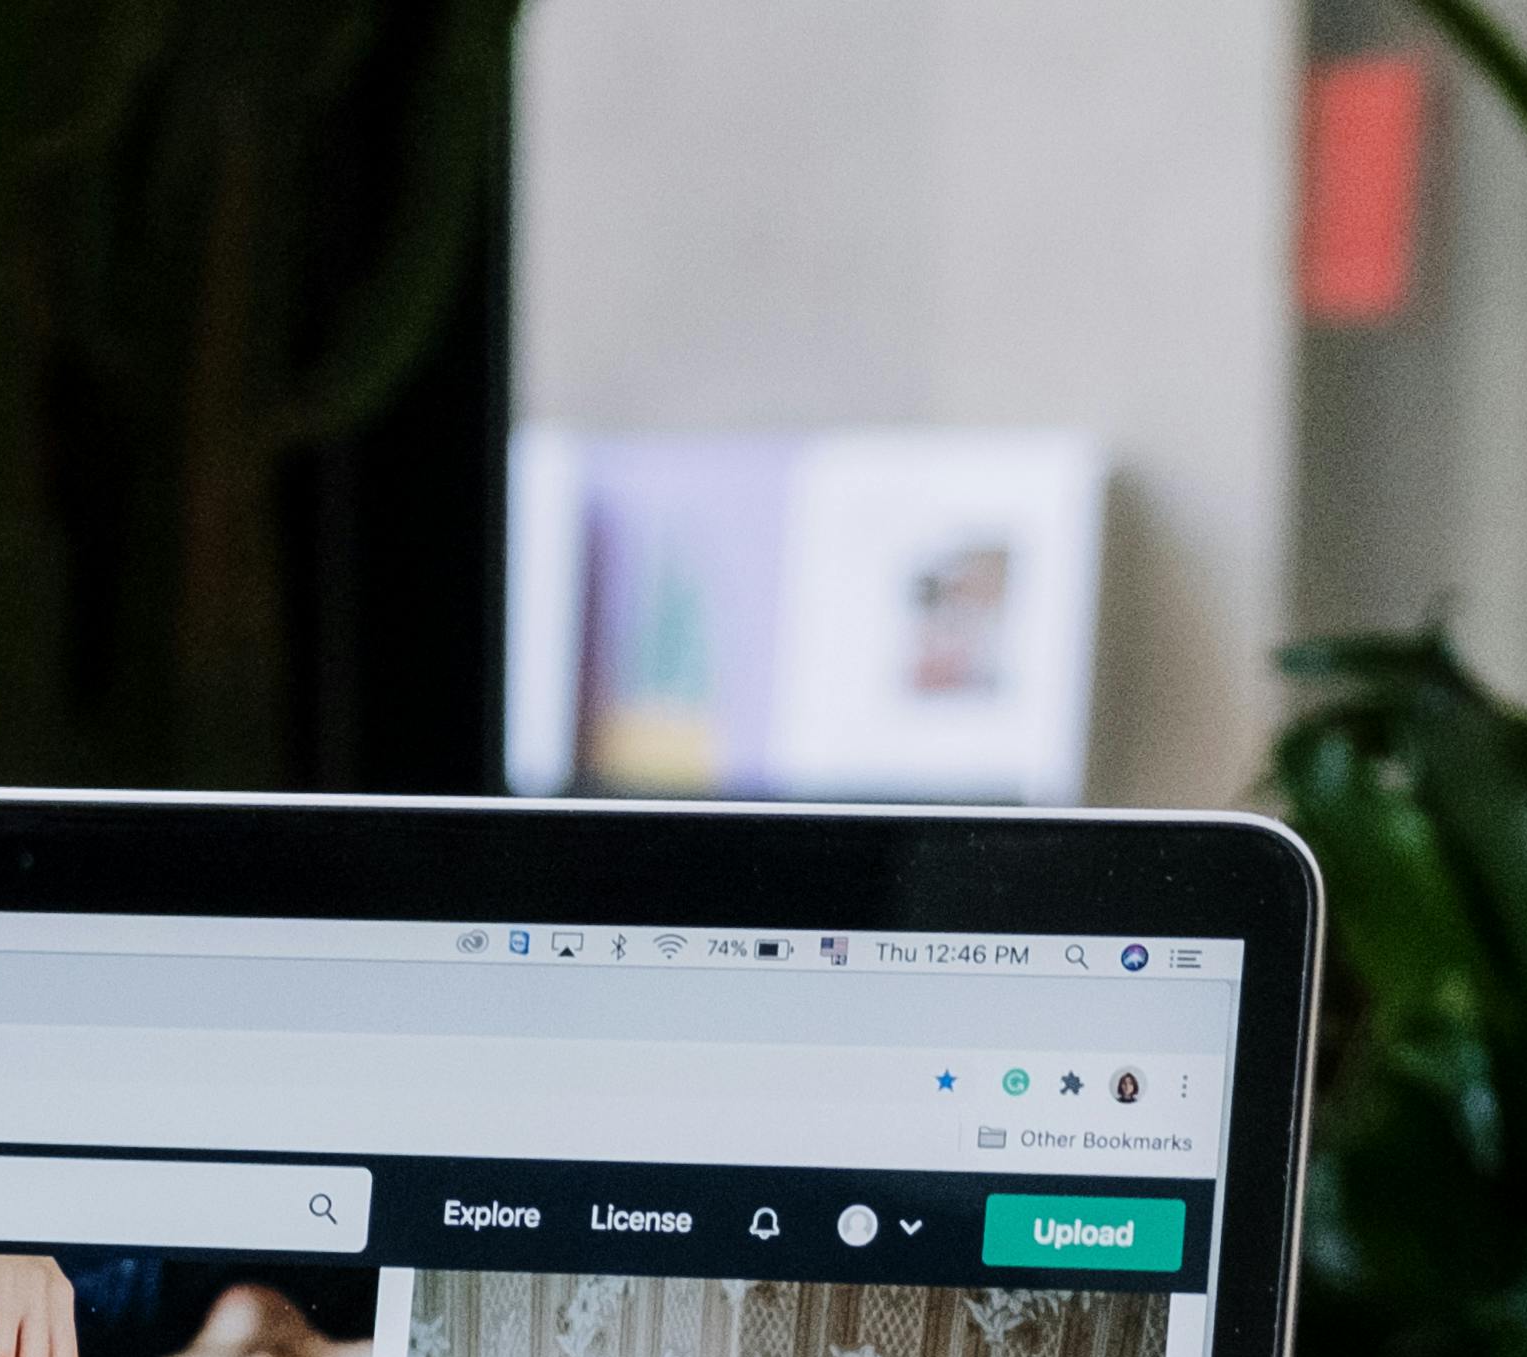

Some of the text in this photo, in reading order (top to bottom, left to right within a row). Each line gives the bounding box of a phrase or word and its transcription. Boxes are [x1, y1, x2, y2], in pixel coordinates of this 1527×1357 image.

[707, 938, 748, 958] 74%
[875, 942, 1030, 965] Thu 12:46 PM
[1020, 1129, 1193, 1152] Other Bookmarks
[443, 1199, 541, 1232] Explore
[590, 1203, 693, 1234] License
[1033, 1217, 1135, 1250] Upload
